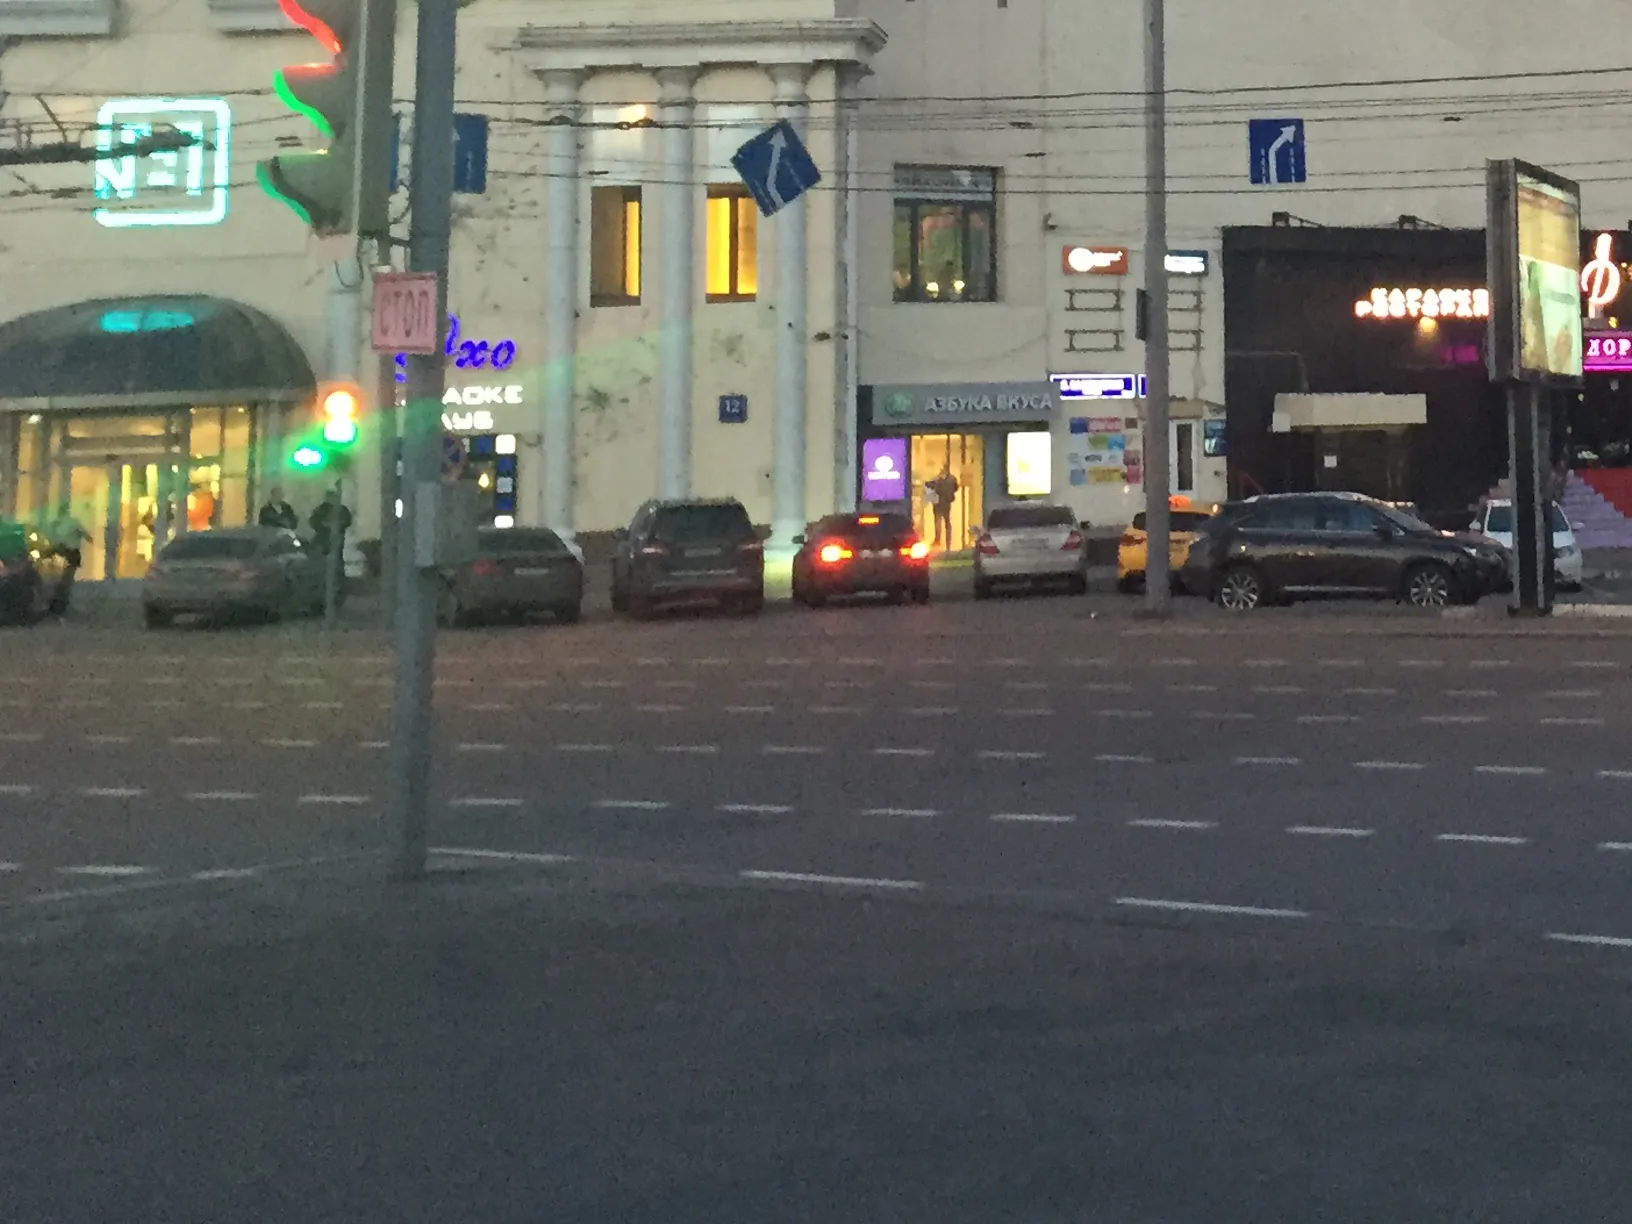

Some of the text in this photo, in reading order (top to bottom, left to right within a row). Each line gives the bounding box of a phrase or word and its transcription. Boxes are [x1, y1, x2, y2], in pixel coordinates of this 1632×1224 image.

[442, 385, 523, 405] АОКЕ
[925, 393, 1053, 412] АЗБУКА ВКУСА
[725, 399, 740, 413] 12
